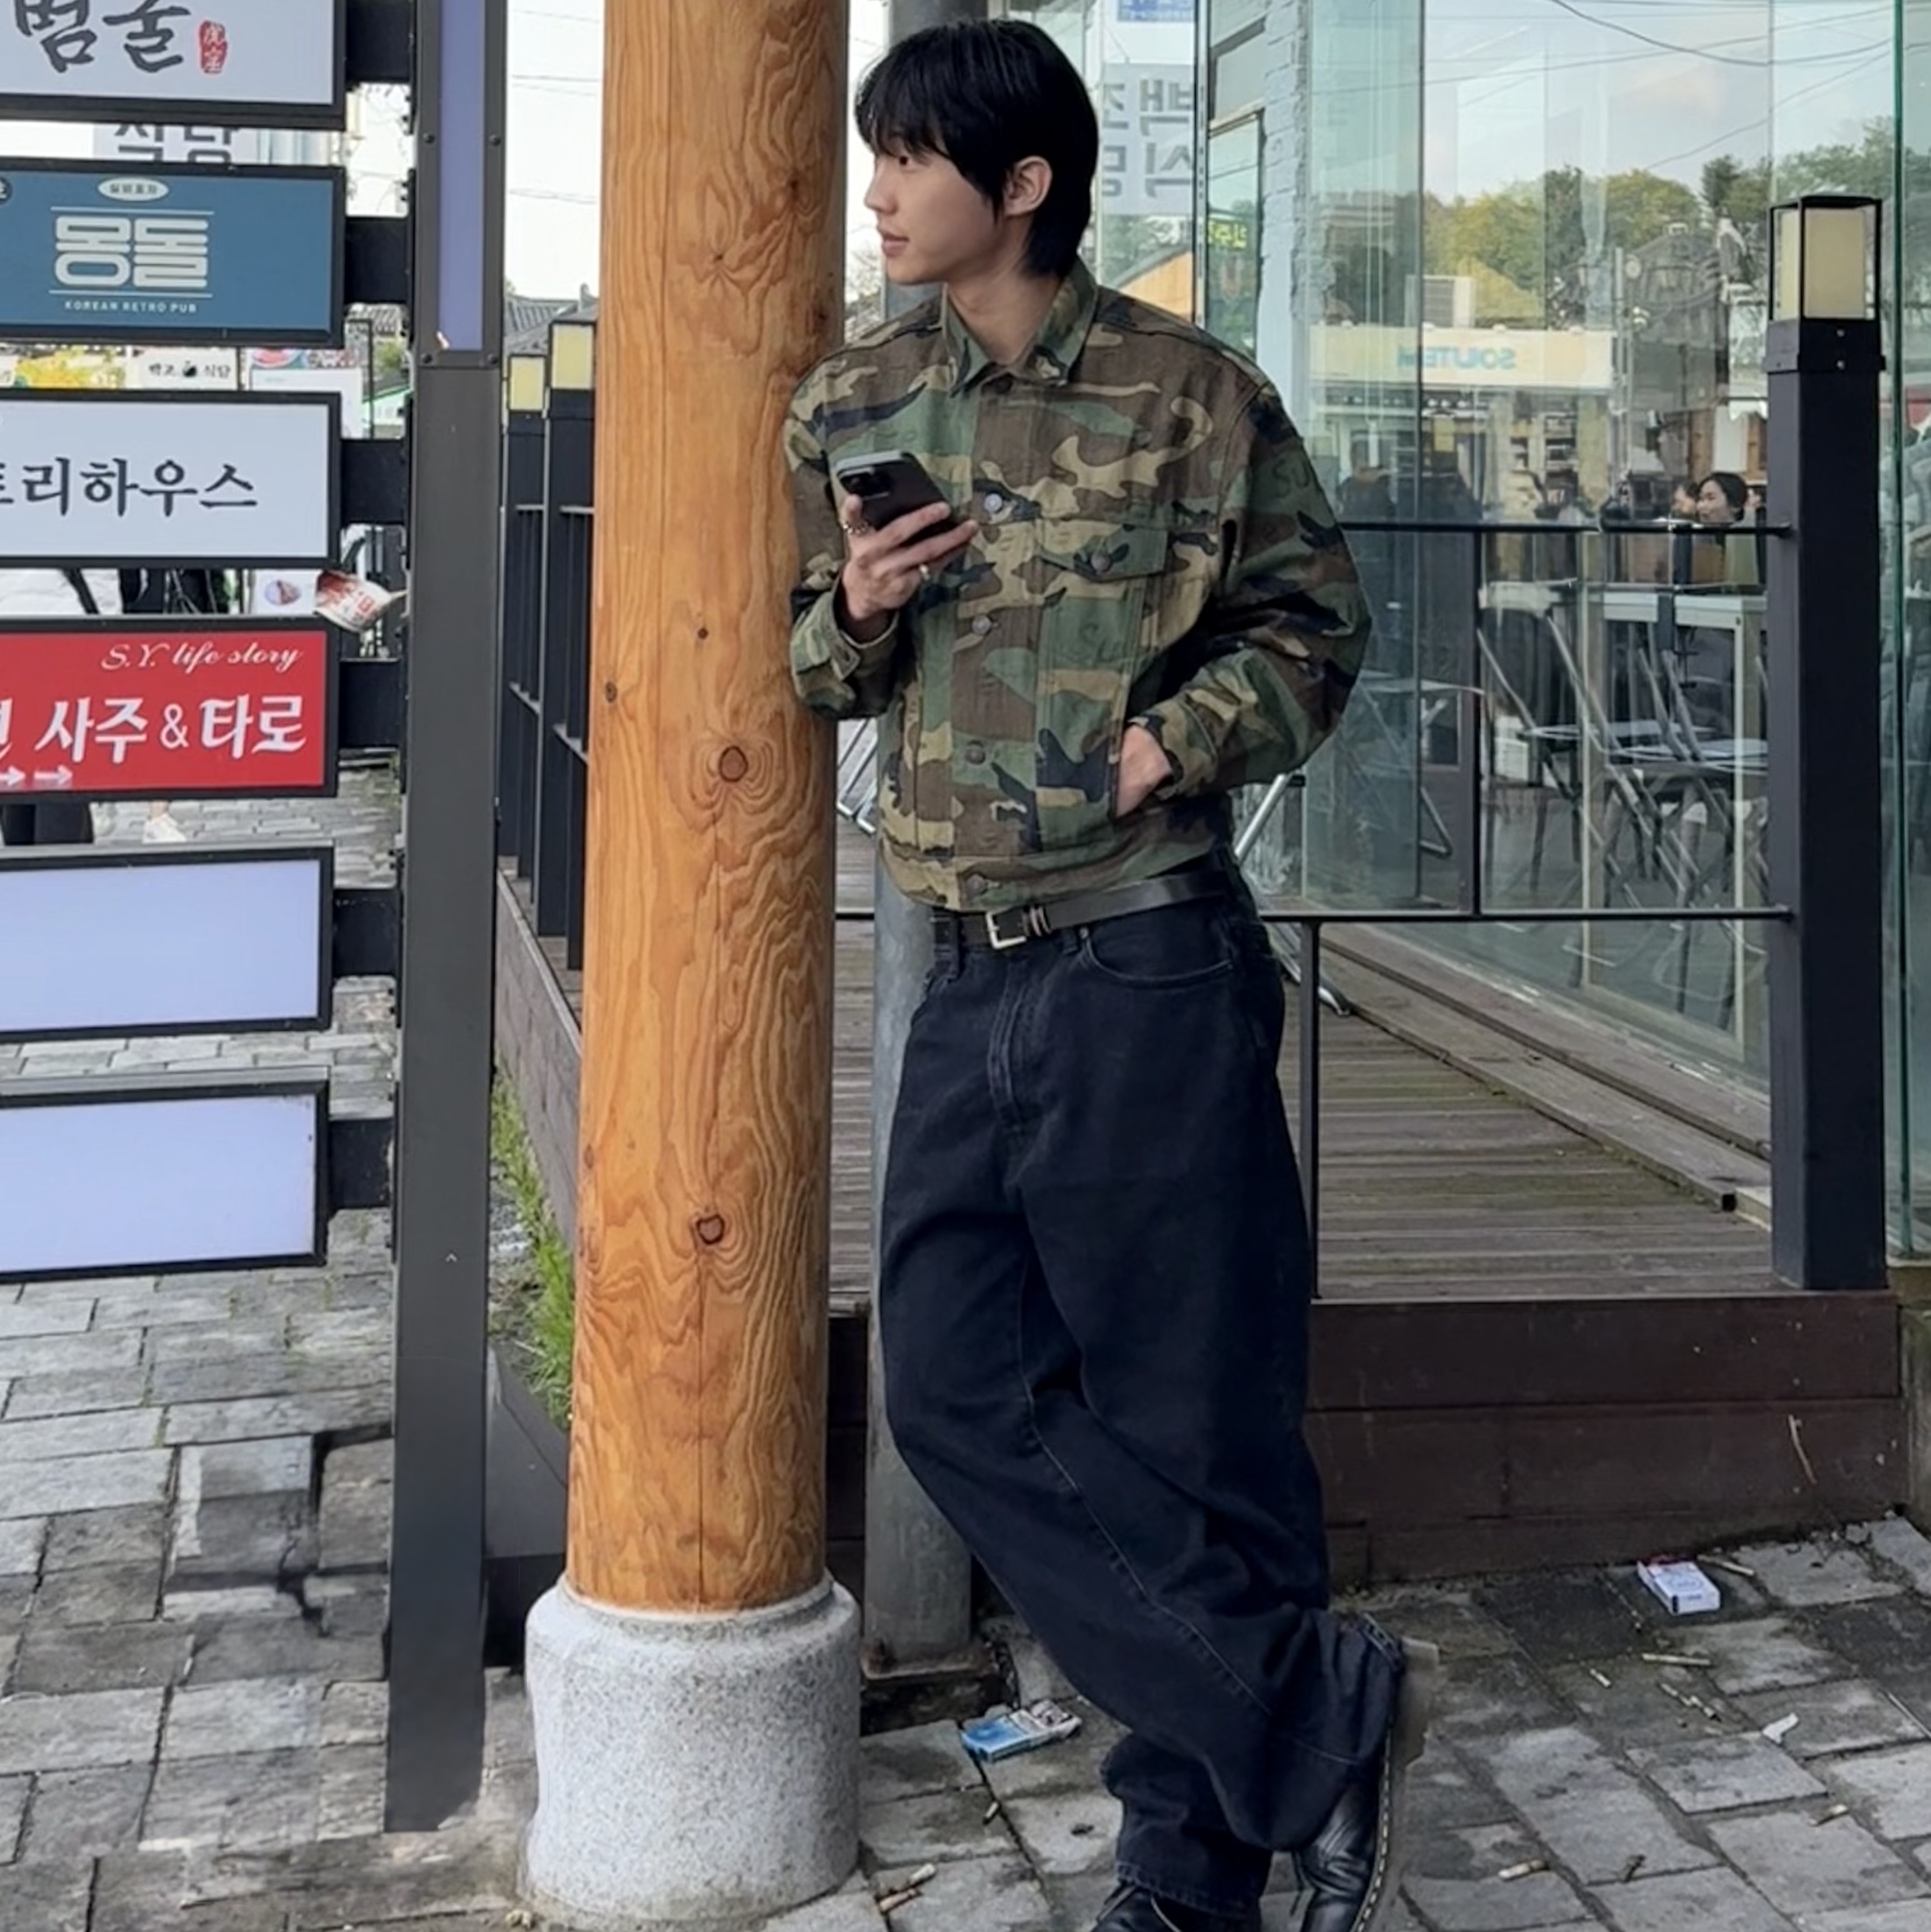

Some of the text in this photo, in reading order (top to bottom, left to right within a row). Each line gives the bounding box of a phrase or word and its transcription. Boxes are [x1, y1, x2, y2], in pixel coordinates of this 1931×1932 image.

[55, 216, 208, 288] 몽돌
[65, 300, 196, 313] KOREAN RETRO PUB
[0, 458, 258, 516] 리하우스
[172, 642, 220, 674] life
[228, 642, 300, 672] story
